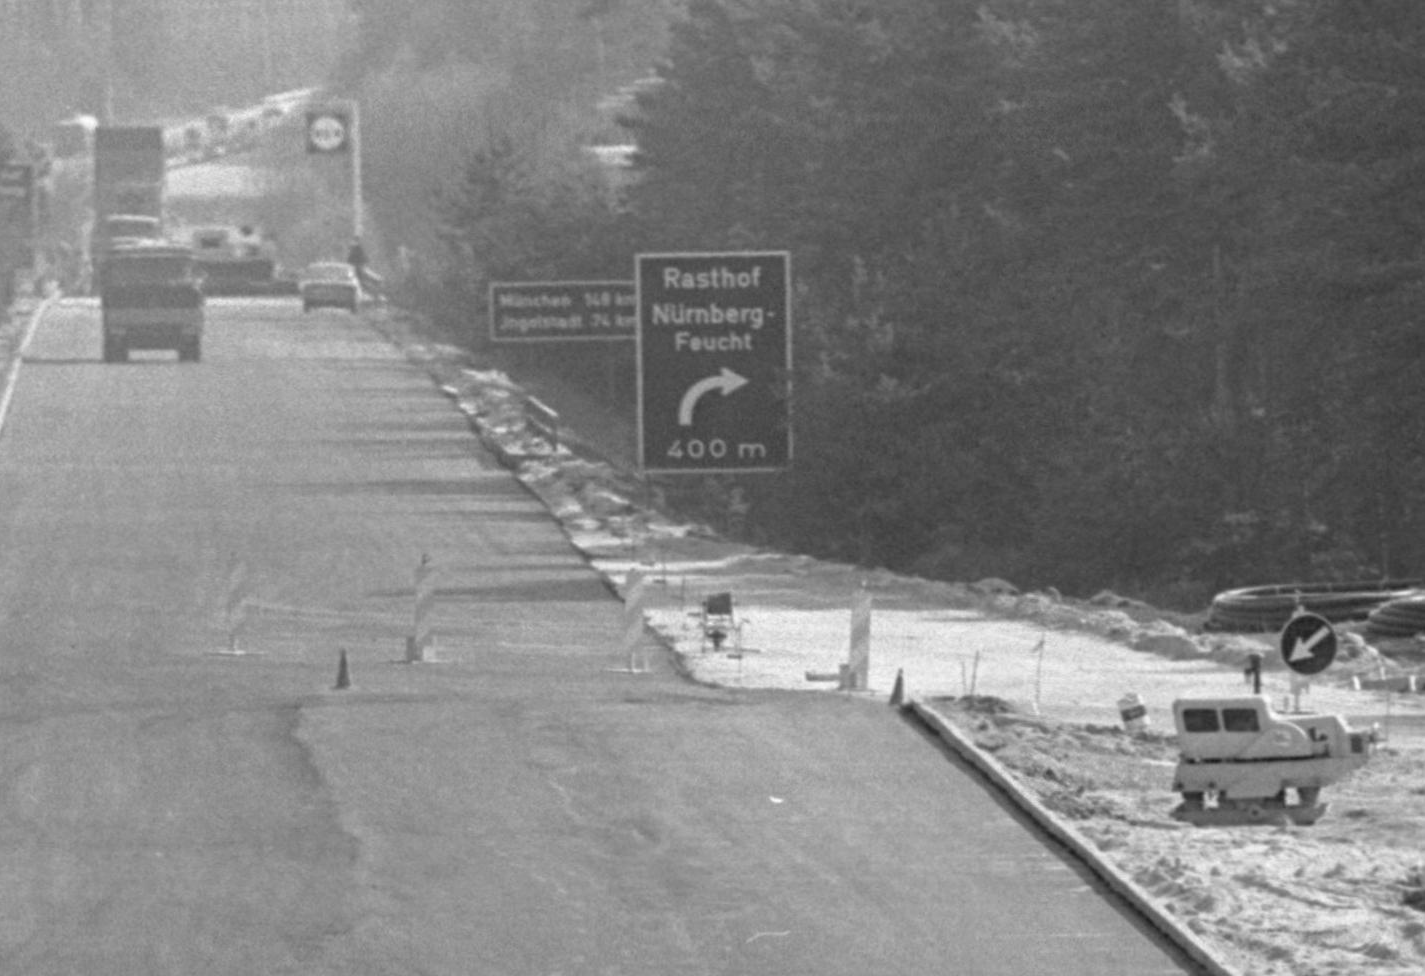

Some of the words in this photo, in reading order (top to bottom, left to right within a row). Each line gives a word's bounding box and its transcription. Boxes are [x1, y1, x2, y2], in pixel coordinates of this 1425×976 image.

[663, 266, 761, 289] Rasthof
[652, 304, 775, 329] Nürnberg-
[675, 331, 752, 351] Feucht
[667, 439, 726, 458] 400
[738, 442, 766, 457] m
